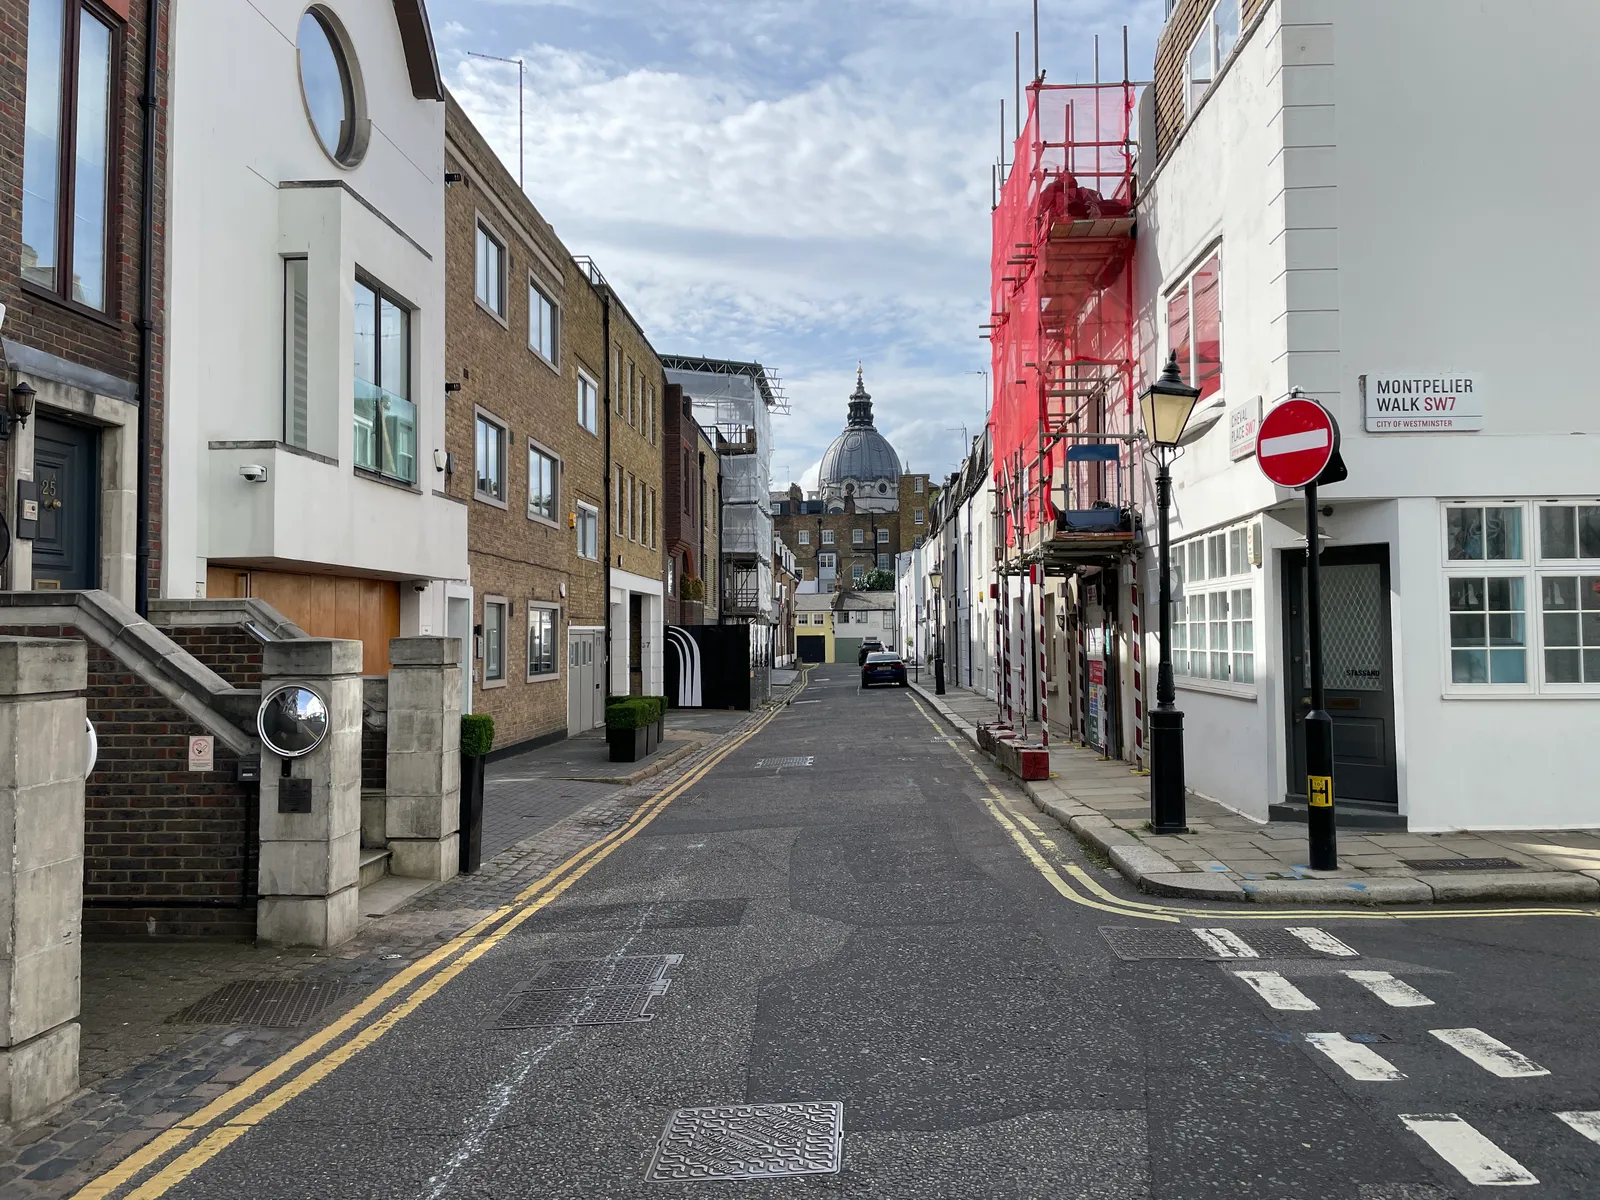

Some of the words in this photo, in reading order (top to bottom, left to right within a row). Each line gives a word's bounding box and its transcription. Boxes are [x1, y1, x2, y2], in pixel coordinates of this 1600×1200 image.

[1377, 379, 1473, 394] MONTPELIER
[1377, 397, 1420, 411] WALK
[1424, 397, 1456, 411] SW7
[1245, 419, 1256, 436] SW7
[42, 480, 56, 496] 25
[738, 1119, 757, 1129] PLC
[780, 1111, 831, 1132] CHIEFTAIN
[756, 1123, 798, 1143] STANTON
[703, 1132, 743, 1150] STANTON
[744, 1147, 762, 1157] PLC
[668, 1144, 718, 1166] CHIEFTAIN
[714, 1162, 736, 1173] 600
